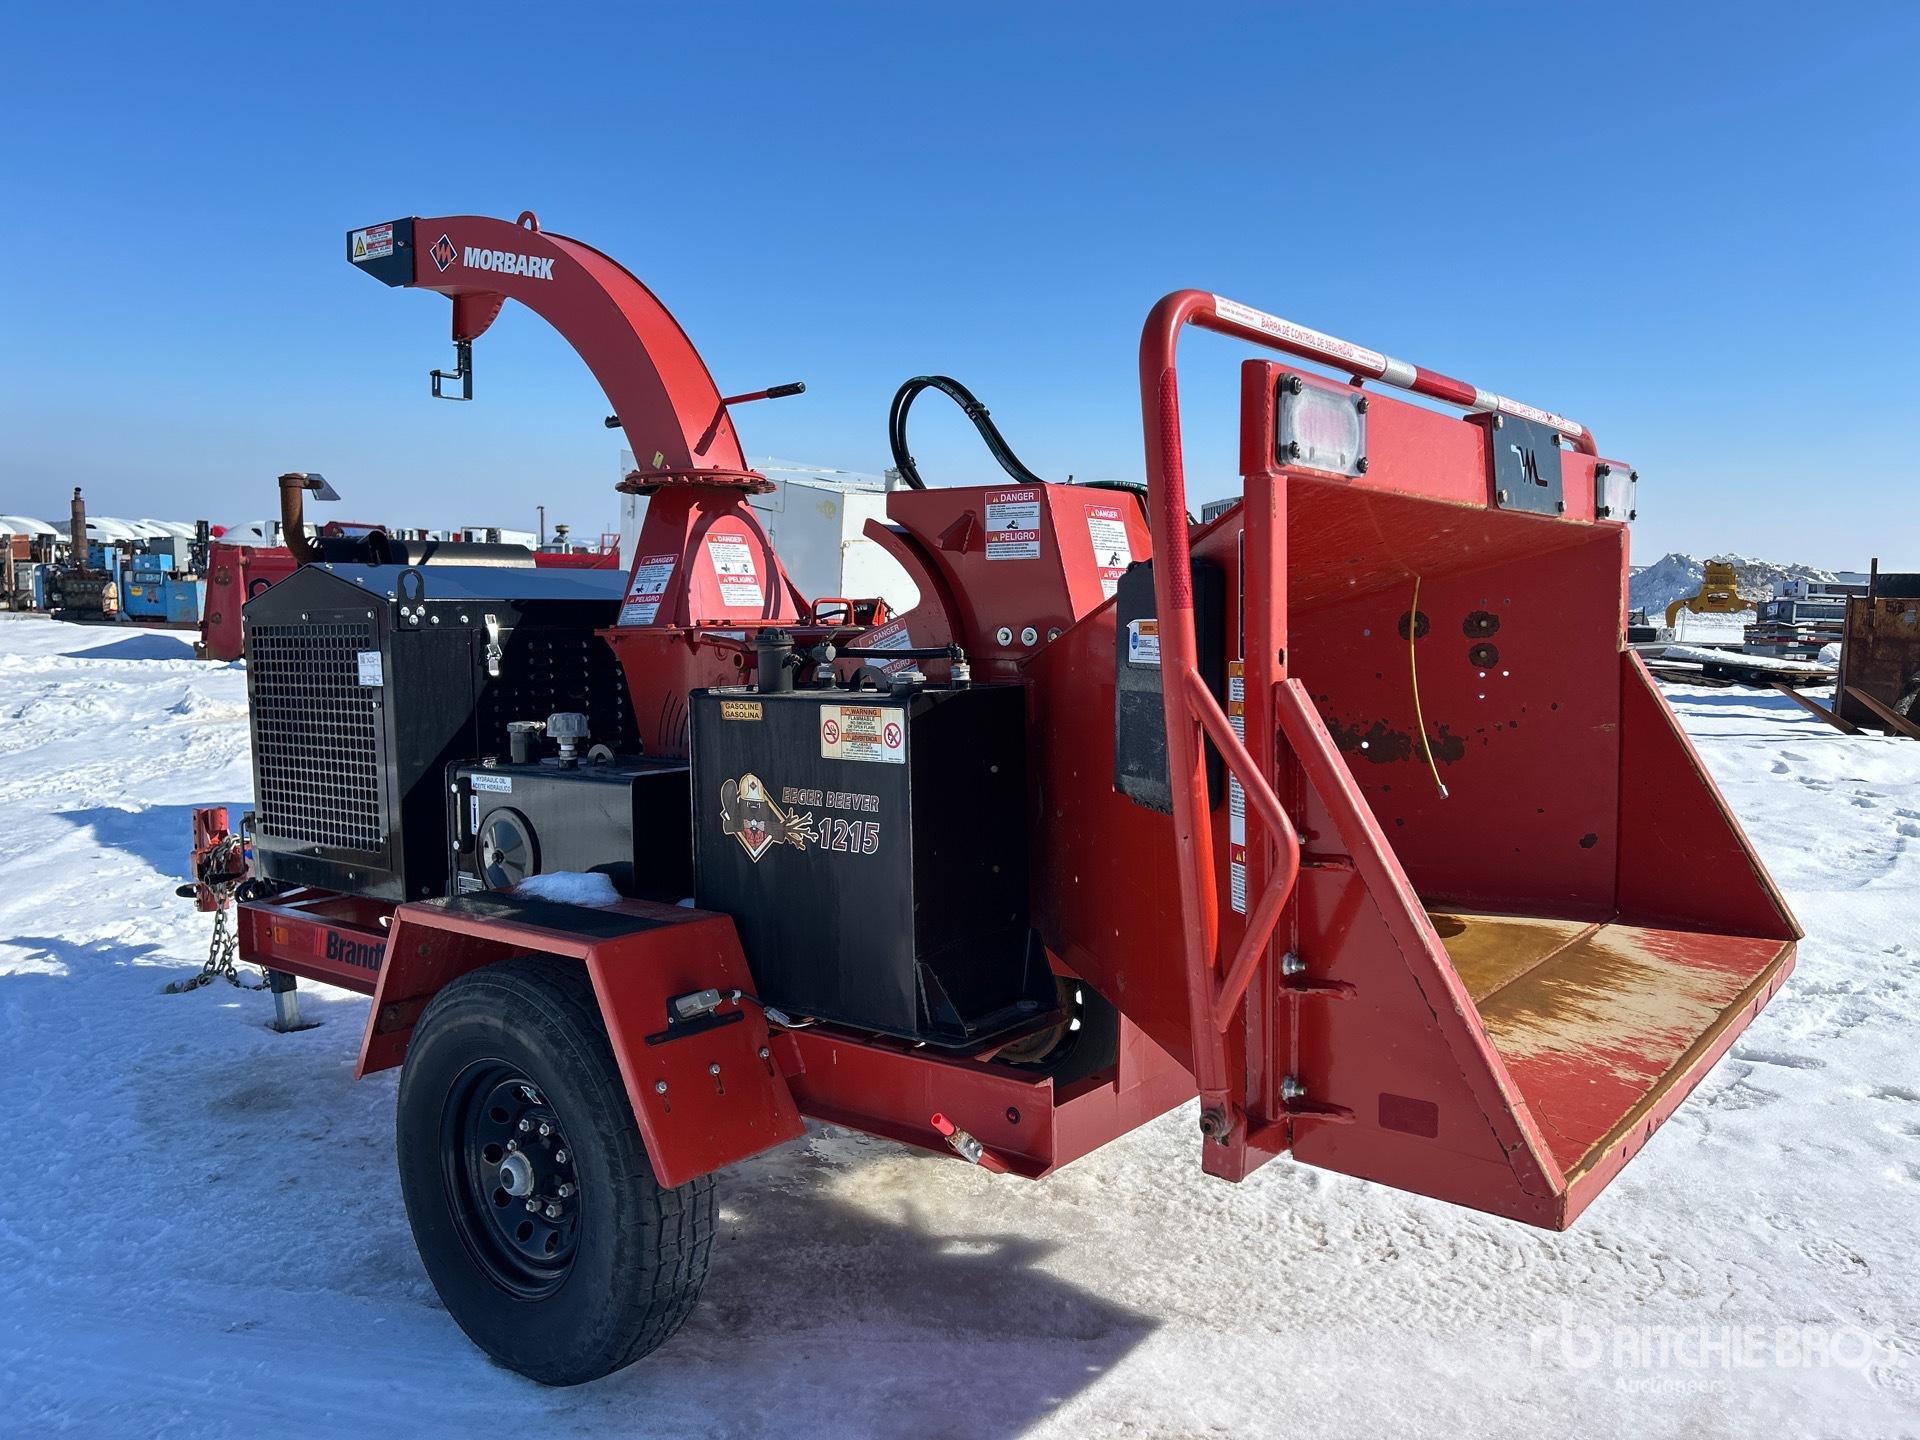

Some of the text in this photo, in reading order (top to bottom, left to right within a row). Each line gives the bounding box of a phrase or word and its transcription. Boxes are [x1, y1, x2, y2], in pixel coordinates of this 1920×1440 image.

[463, 246, 555, 281] MORBARK
[1261, 318, 1282, 334] BARRA
[1282, 325, 1290, 337] DE
[1291, 328, 1316, 347] CONTROL
[1317, 337, 1324, 348] DE
[1325, 339, 1354, 358] SEGURIDAD
[1000, 492, 1035, 503] DANGER
[1095, 508, 1119, 519] DANGER
[717, 535, 744, 543] DANGER
[1000, 531, 1036, 542] PELIGRO
[650, 556, 675, 564] DANGER
[727, 575, 755, 584] PELIGRO
[634, 595, 660, 603] PELIGRO
[873, 623, 900, 642] DANGER
[882, 659, 910, 674] PELIGRO
[725, 711, 760, 719] GASOLINA
[782, 787, 880, 812] EEGER BEEVER
[818, 817, 880, 854] 1215
